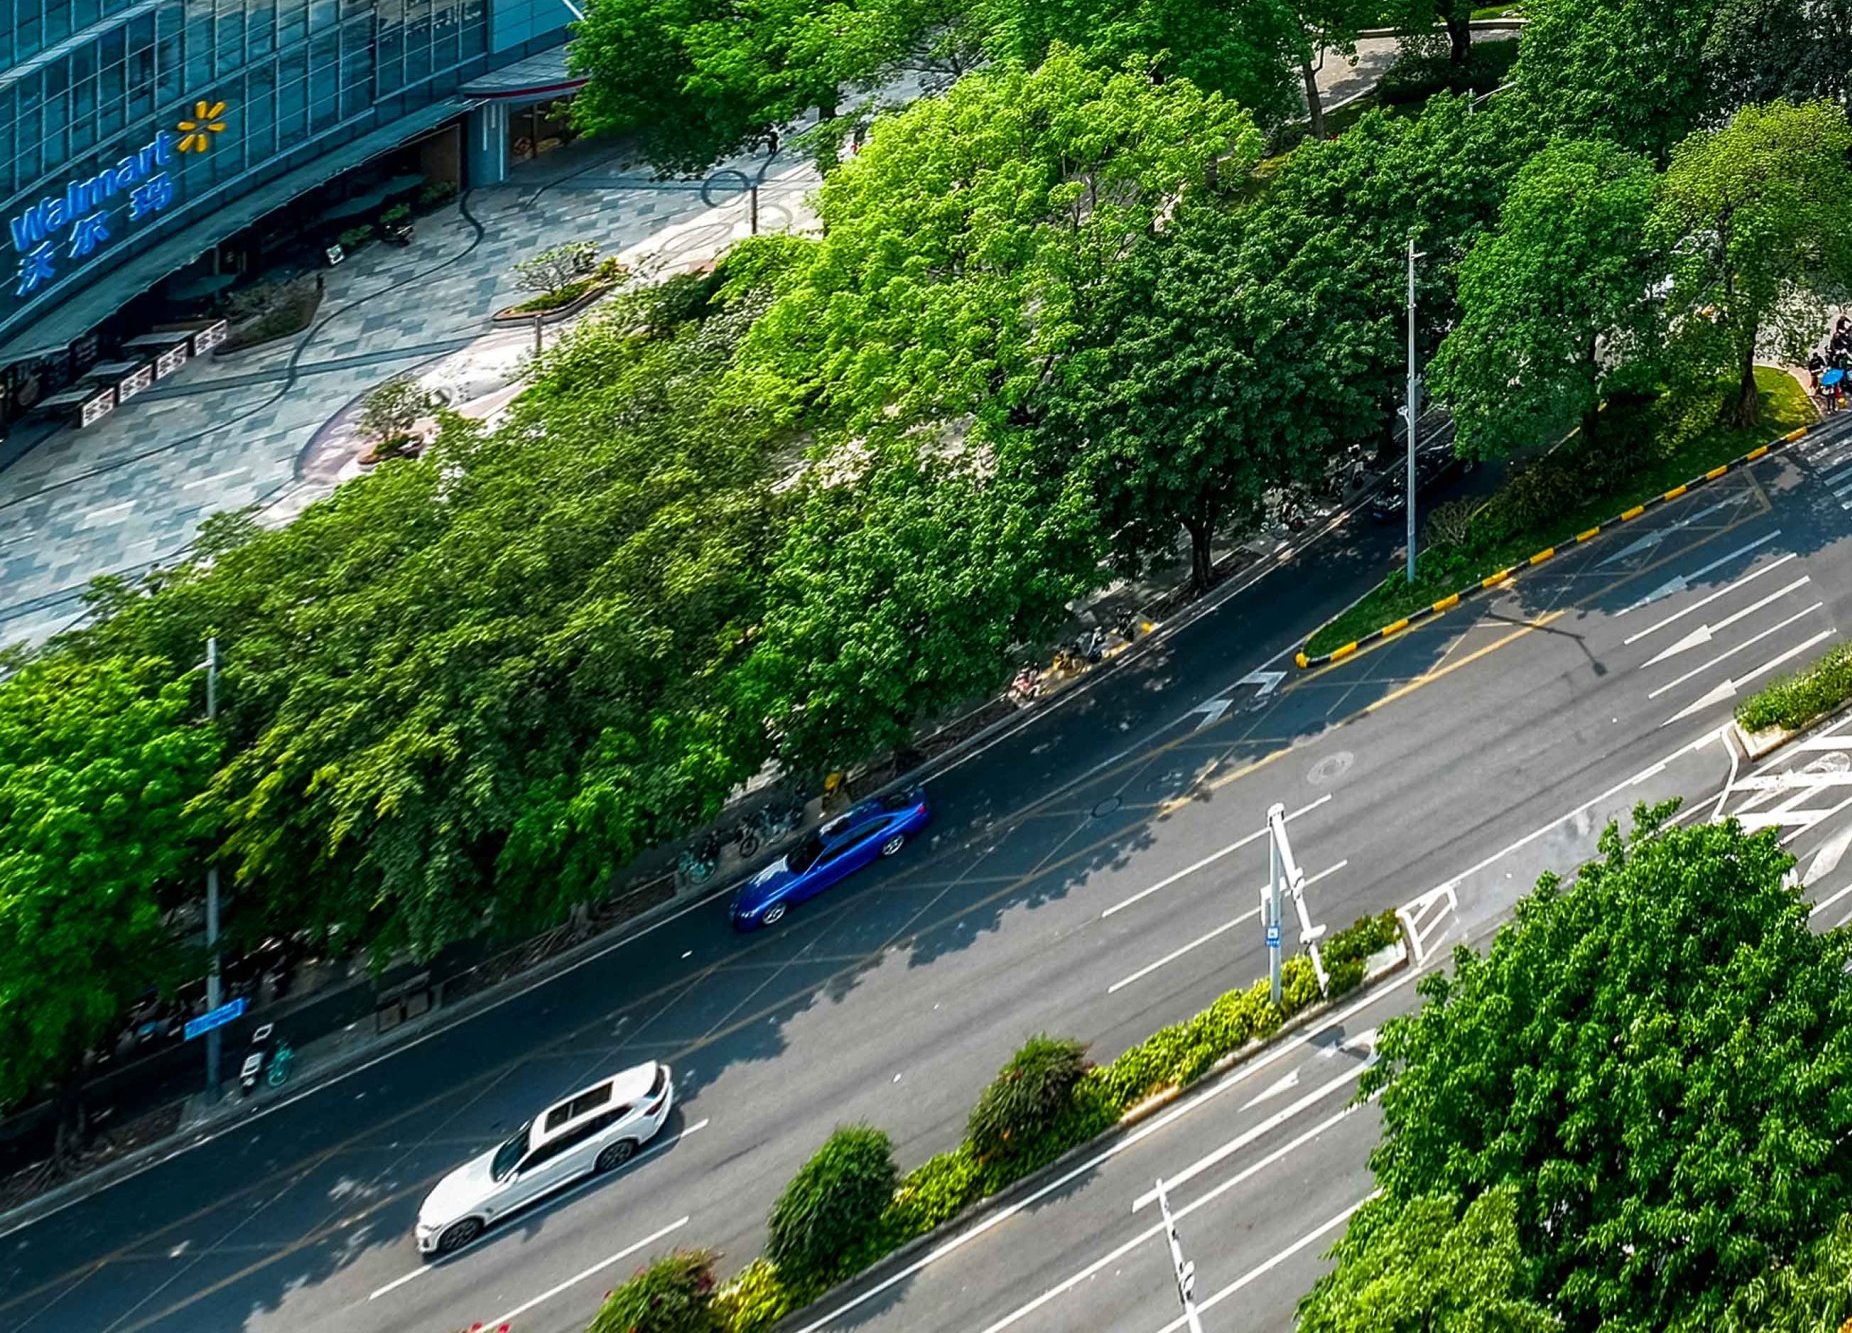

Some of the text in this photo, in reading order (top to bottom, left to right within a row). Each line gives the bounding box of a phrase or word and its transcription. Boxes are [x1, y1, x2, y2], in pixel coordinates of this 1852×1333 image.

[10, 130, 172, 252] Walmart
[14, 171, 173, 297] 沃尔玛
